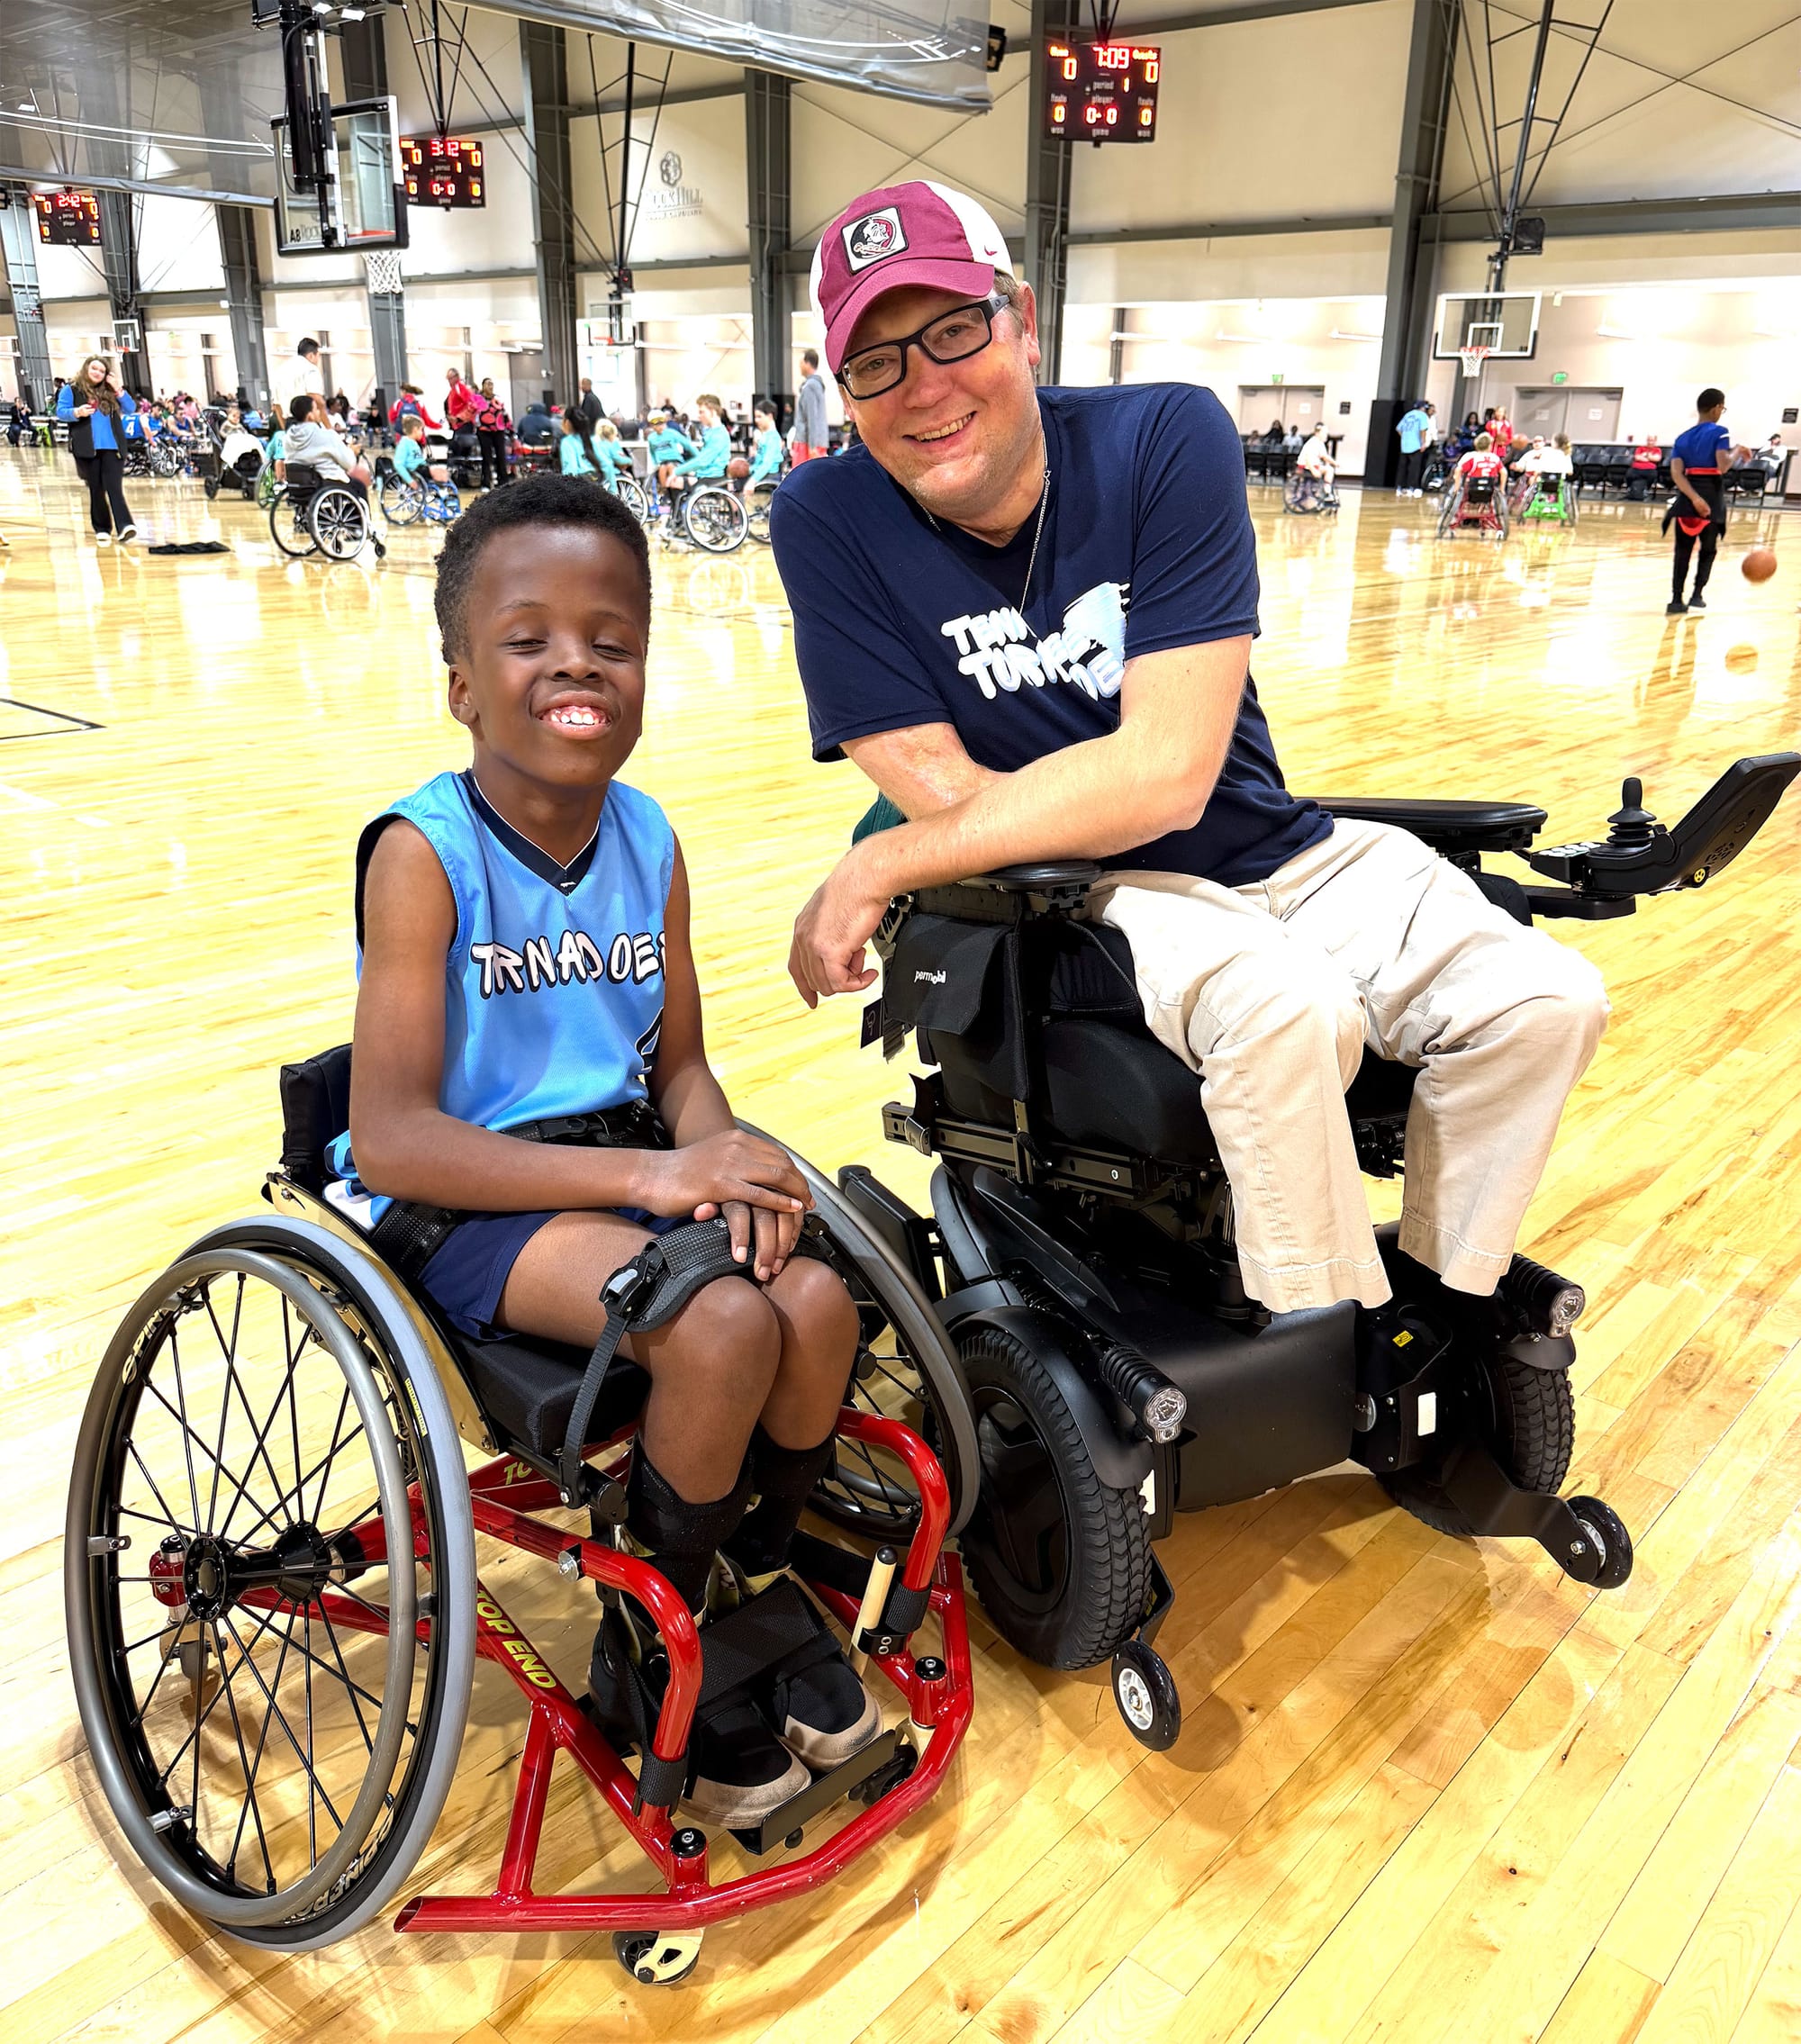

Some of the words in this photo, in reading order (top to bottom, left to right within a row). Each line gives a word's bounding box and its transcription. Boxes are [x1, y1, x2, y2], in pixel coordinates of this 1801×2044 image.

[1092, 47, 1130, 68] 7:09
[1063, 58, 1077, 80] 0
[1145, 61, 1159, 83] 0
[1054, 105, 1065, 122] 0
[1141, 108, 1153, 126] 0
[412, 148, 422, 165] 0
[431, 140, 459, 157] 3:12
[471, 149, 482, 167] 0
[44, 201, 52, 213] 0
[58, 195, 80, 208] 2:42
[90, 203, 98, 215] 0
[471, 929, 666, 999] TRNADOE
[914, 970, 946, 985] permobil
[503, 1461, 533, 1486] TO
[477, 1589, 516, 1634] TOP
[502, 1640, 557, 1689] END
